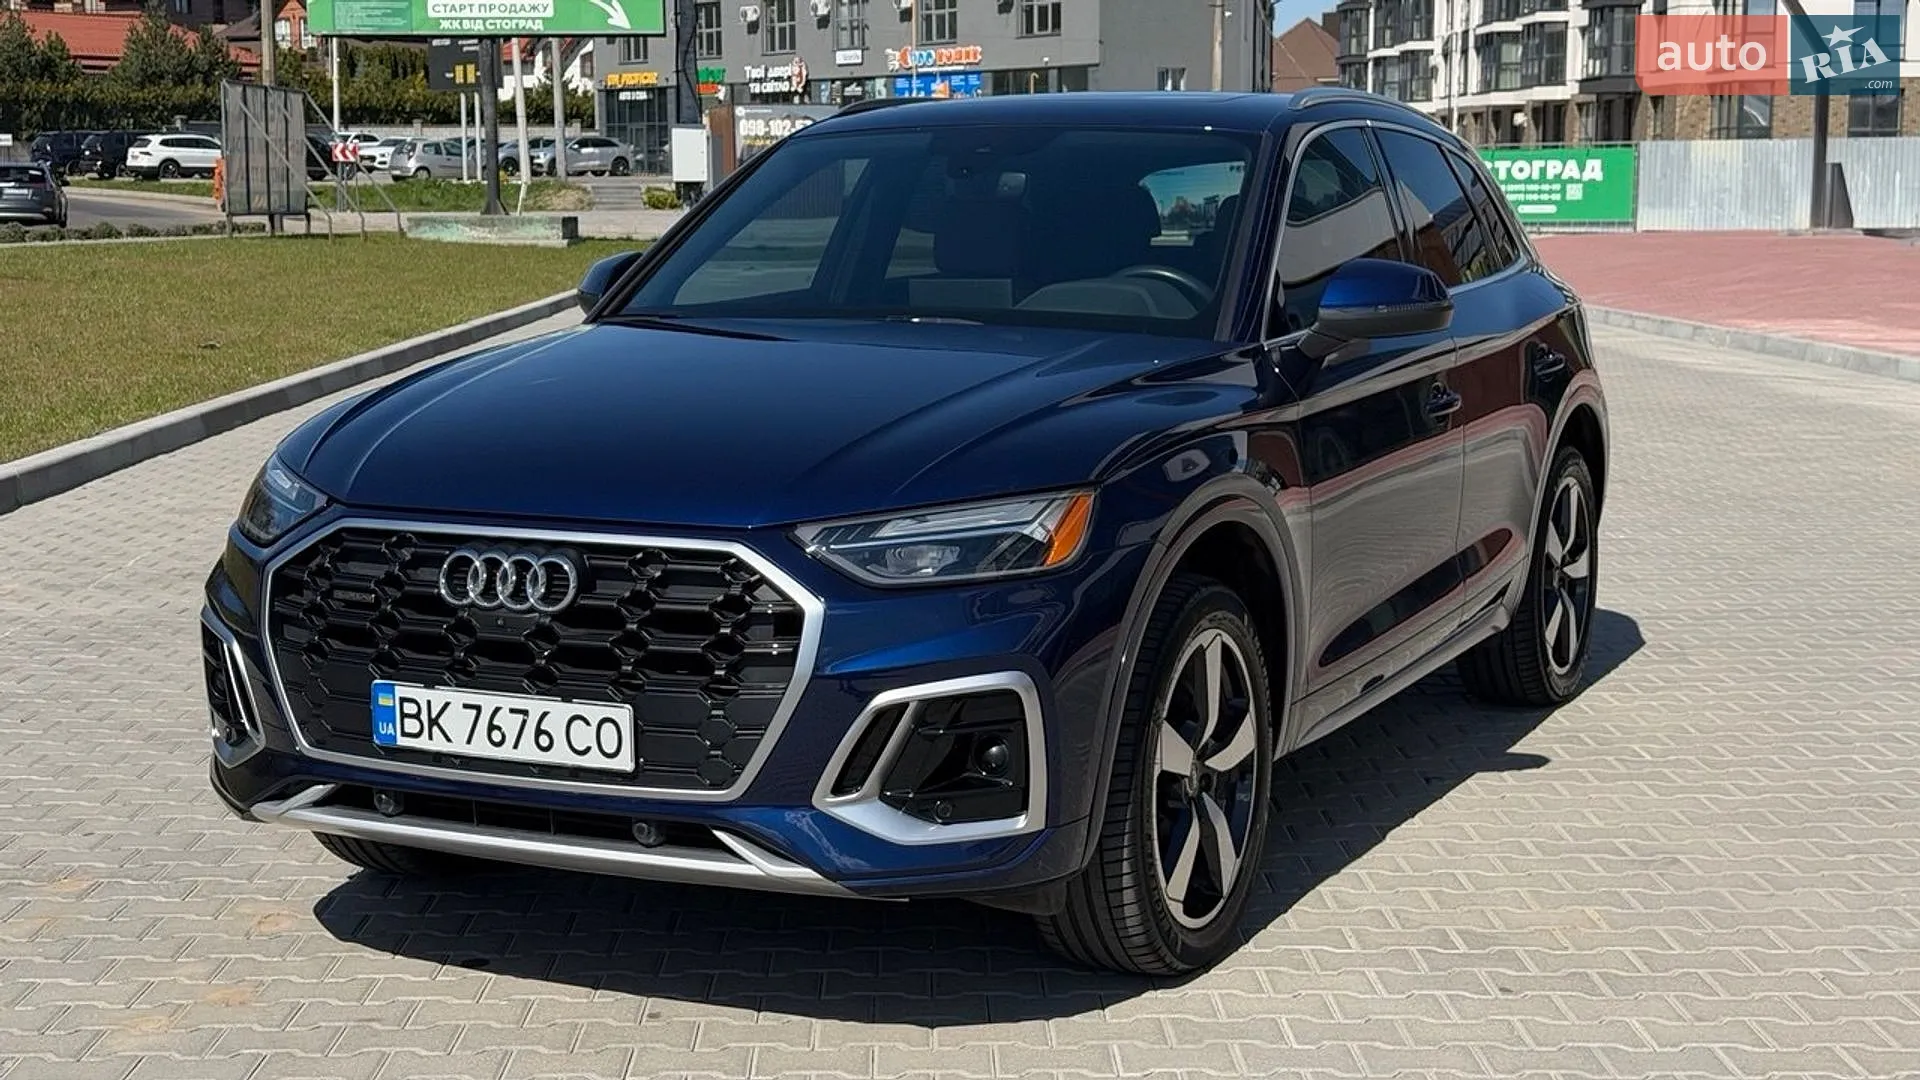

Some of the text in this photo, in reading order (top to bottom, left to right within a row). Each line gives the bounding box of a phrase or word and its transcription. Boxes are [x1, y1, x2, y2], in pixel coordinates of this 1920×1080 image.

[432, 3, 549, 14] СТАРТ ПРОДАЖУ
[440, 19, 544, 31] ЖК ВІД СТОГРАД
[1484, 158, 1604, 183] ТОГРАД
[378, 721, 396, 736] UA
[398, 696, 623, 760] BK 7676 CO
